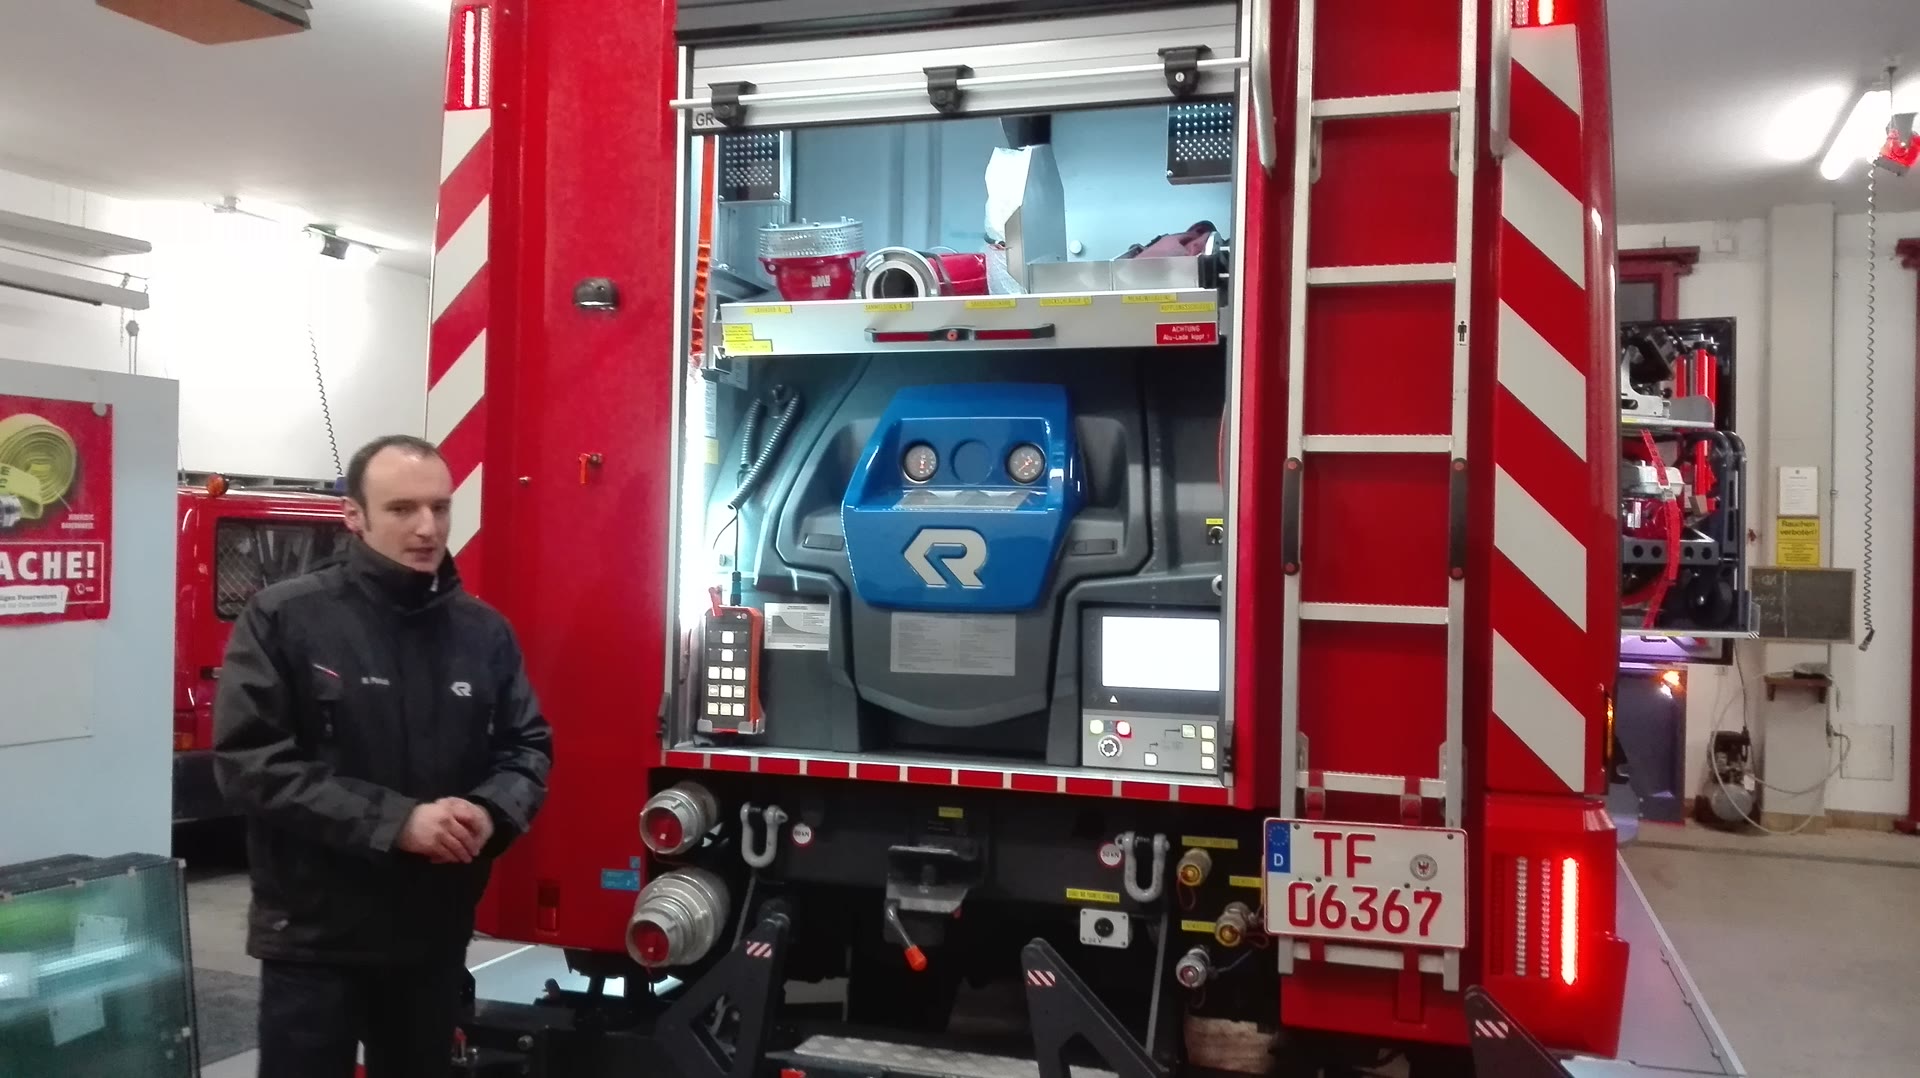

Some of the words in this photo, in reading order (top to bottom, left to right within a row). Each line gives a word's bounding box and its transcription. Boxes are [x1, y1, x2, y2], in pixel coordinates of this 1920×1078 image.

[1171, 325, 1201, 333] ACHTUNG
[1273, 853, 1284, 867] D
[1313, 831, 1376, 878] TF
[1288, 881, 1442, 937] 06367
